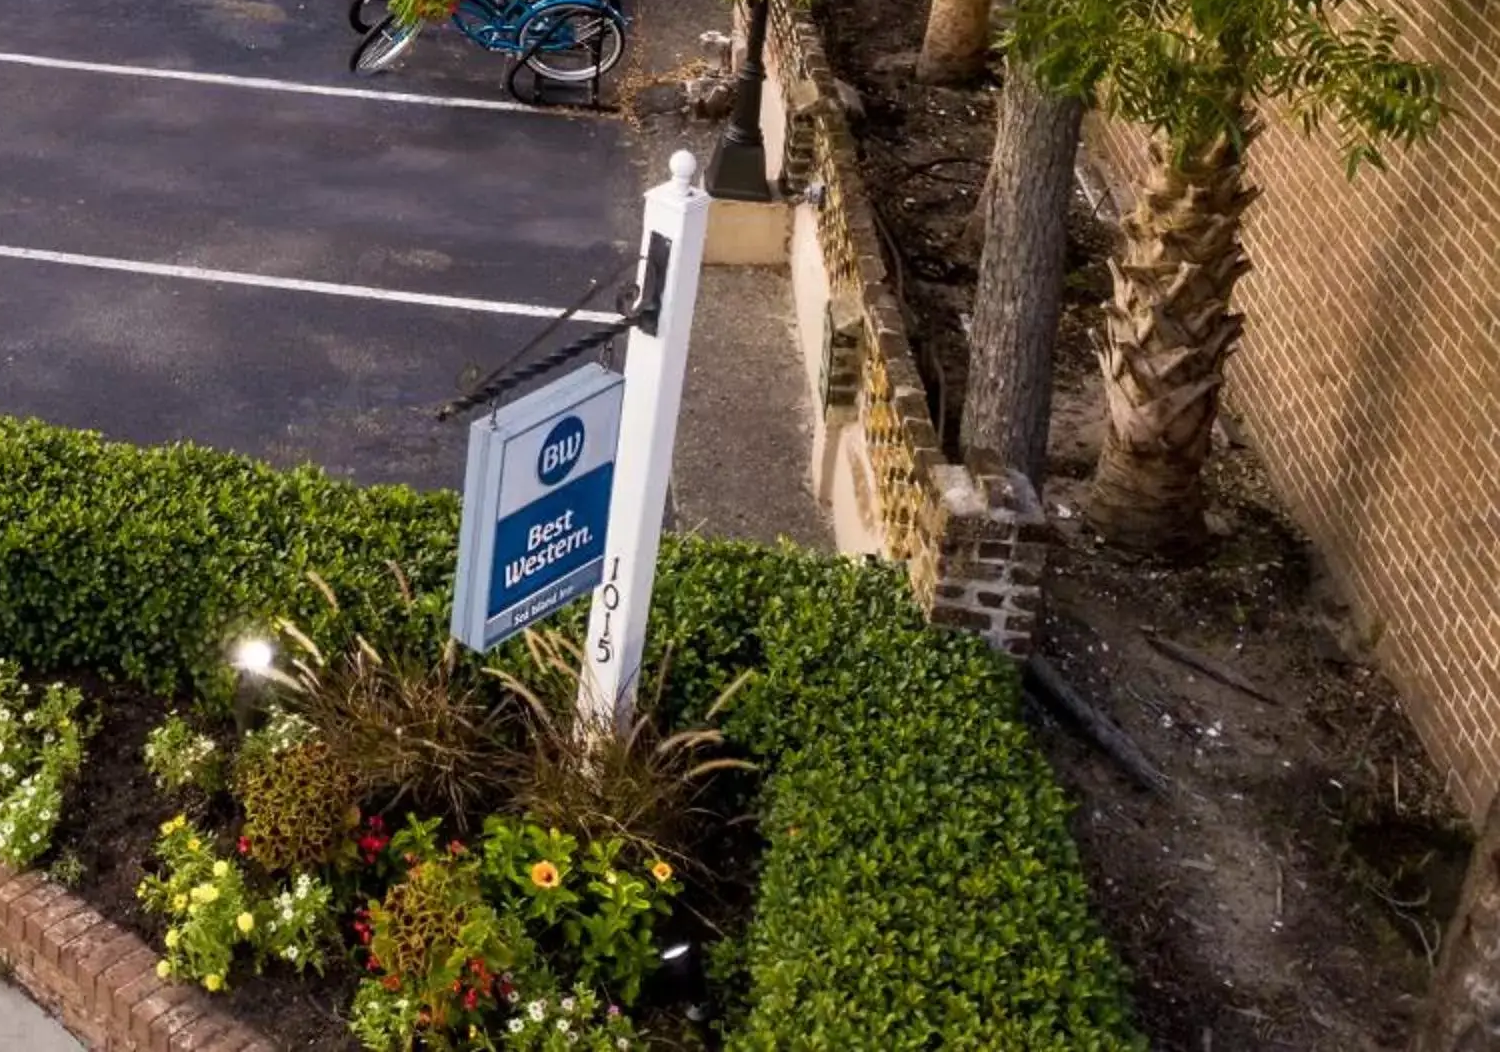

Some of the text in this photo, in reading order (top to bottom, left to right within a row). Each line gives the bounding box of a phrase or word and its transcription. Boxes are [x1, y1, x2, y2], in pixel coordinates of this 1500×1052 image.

[543, 431, 582, 475] BW
[527, 509, 575, 552] Best
[596, 556, 620, 663] 1015
